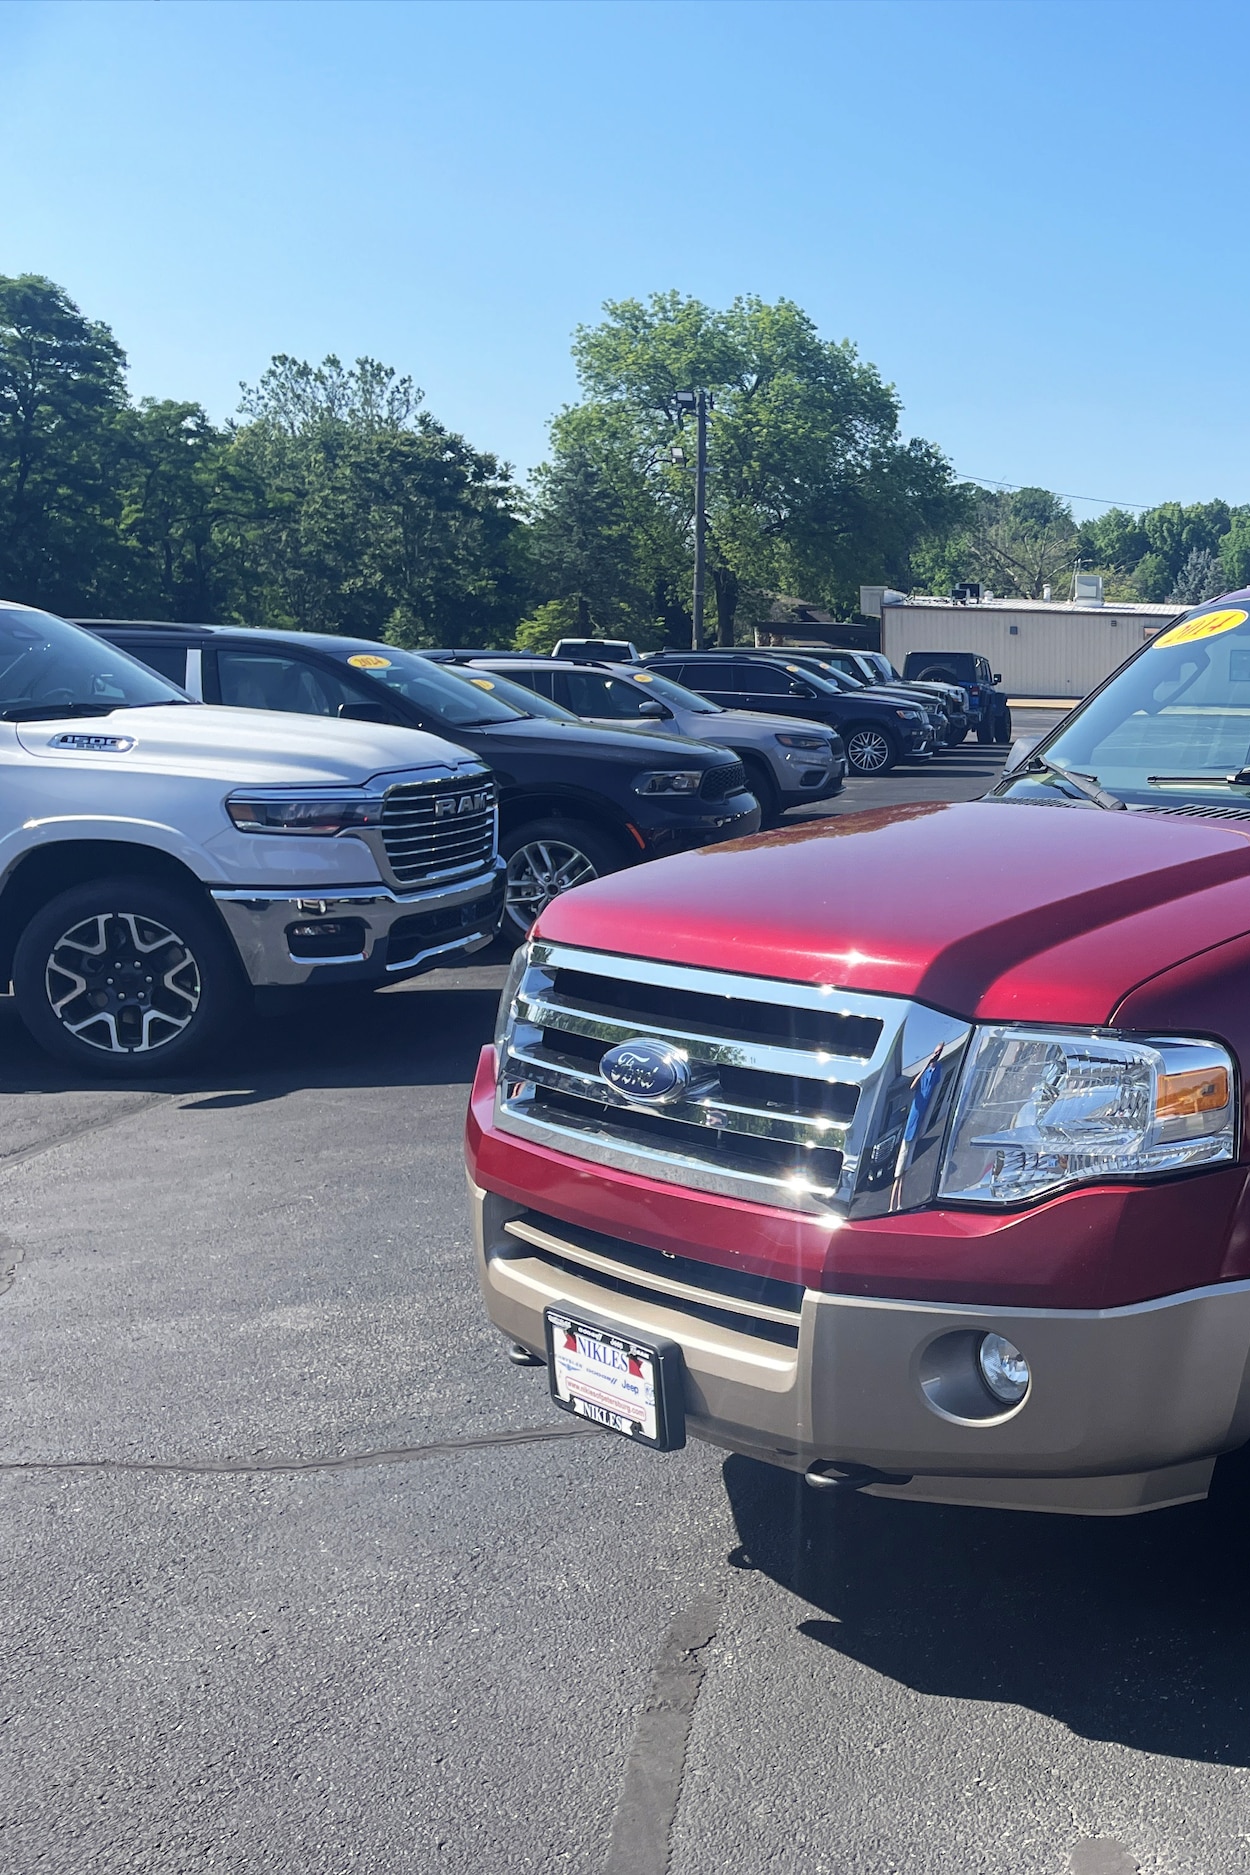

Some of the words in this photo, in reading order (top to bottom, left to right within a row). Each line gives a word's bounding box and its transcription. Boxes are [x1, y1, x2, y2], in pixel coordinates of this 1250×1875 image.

[1164, 613, 1239, 644] 2014
[435, 792, 487, 817] RAM
[610, 1052, 659, 1089] Ford
[575, 1335, 629, 1373] NIKLES
[621, 1380, 640, 1395] Jeep
[584, 1402, 623, 1431] NIKLES
